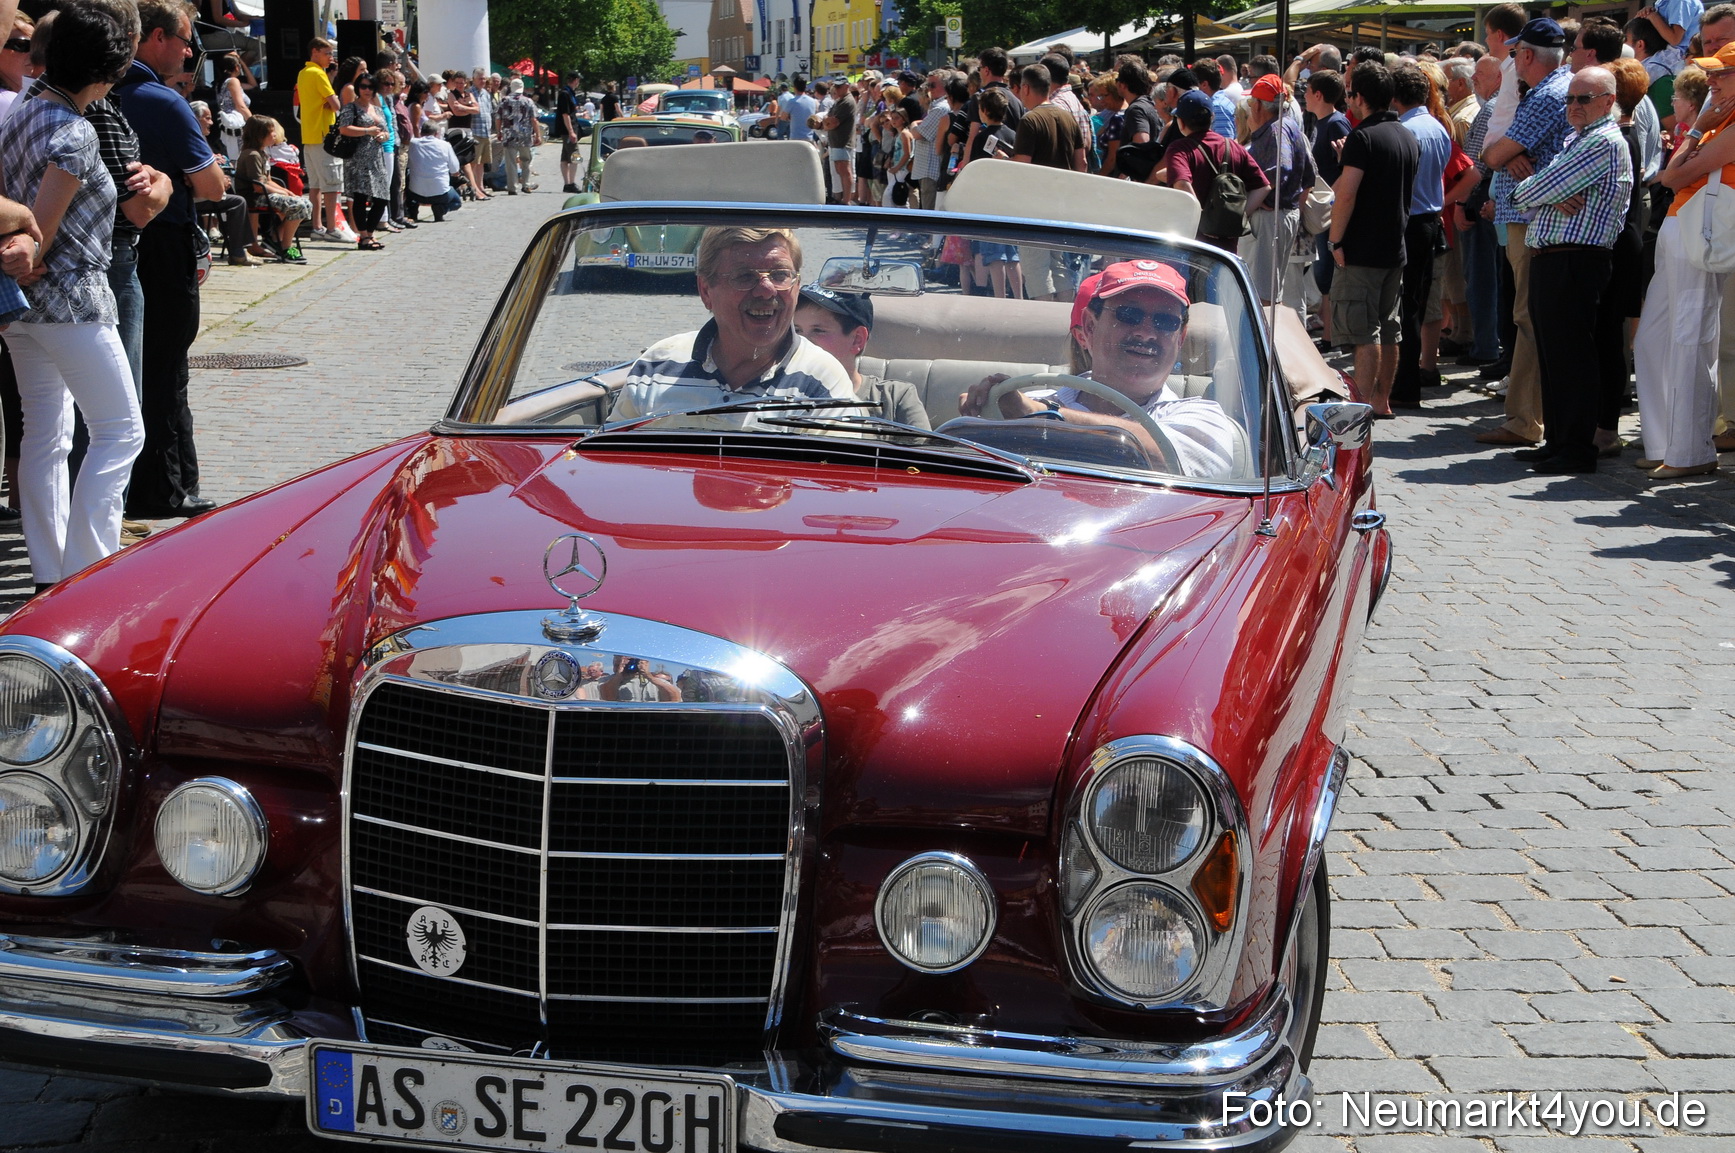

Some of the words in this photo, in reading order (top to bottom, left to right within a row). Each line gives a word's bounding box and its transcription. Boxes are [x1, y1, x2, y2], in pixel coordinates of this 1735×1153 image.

[635, 255, 650, 266] RH
[655, 256, 670, 266] UW
[329, 1098, 343, 1116] D
[355, 1064, 426, 1130] AS
[474, 1075, 547, 1143] SE
[565, 1084, 720, 1153] 220H
